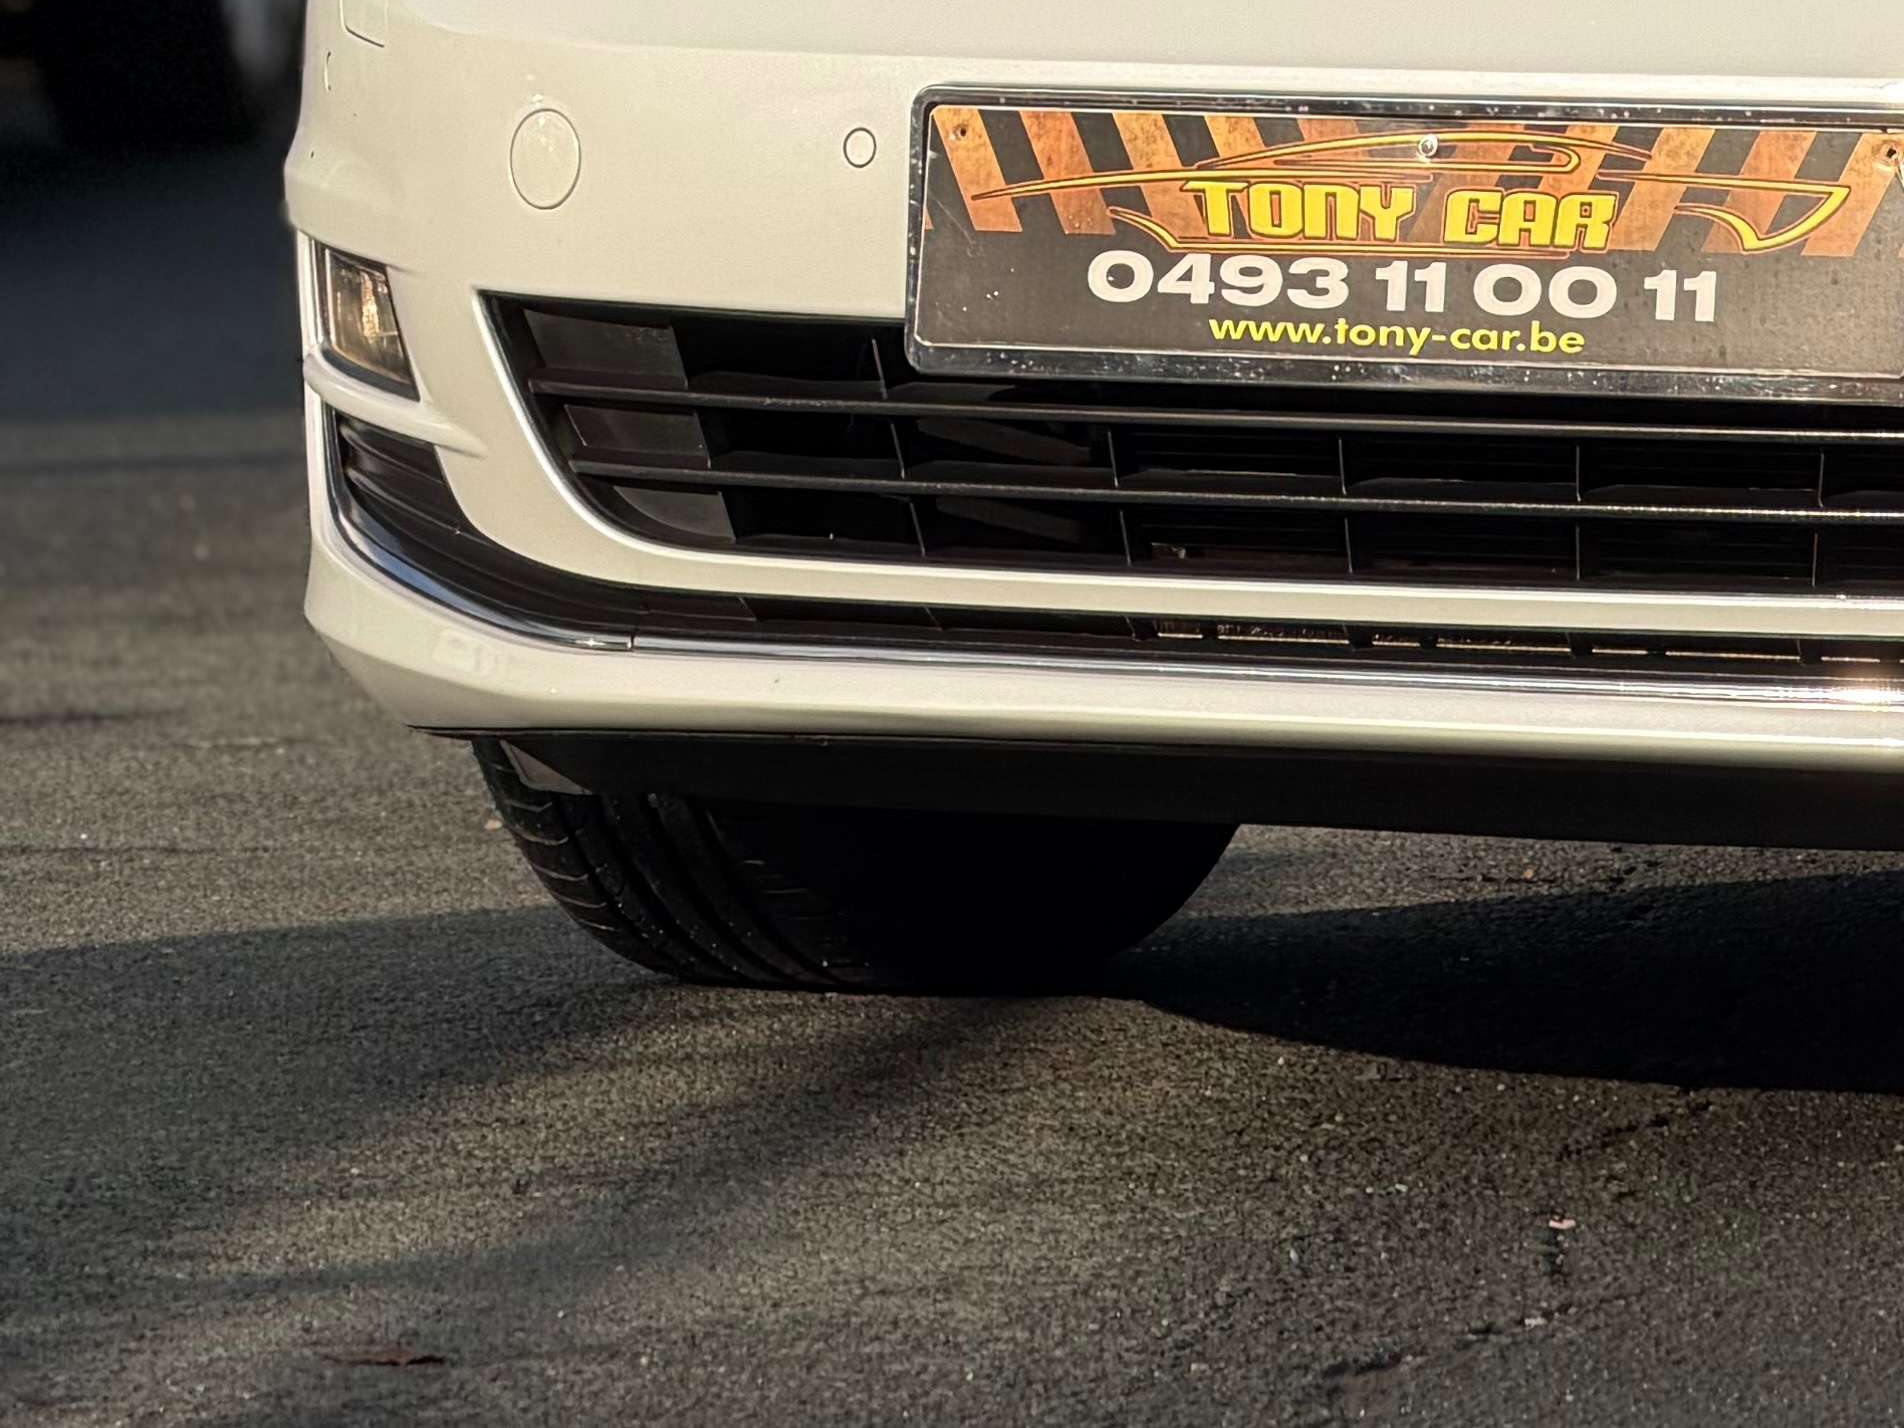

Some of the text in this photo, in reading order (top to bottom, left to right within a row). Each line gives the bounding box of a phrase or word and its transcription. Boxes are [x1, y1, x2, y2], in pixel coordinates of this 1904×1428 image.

[1182, 178, 1618, 252] TONY CAR
[1087, 249, 1720, 323] 0493 11 00 11
[1207, 317, 1587, 357] www.tony-car.be
